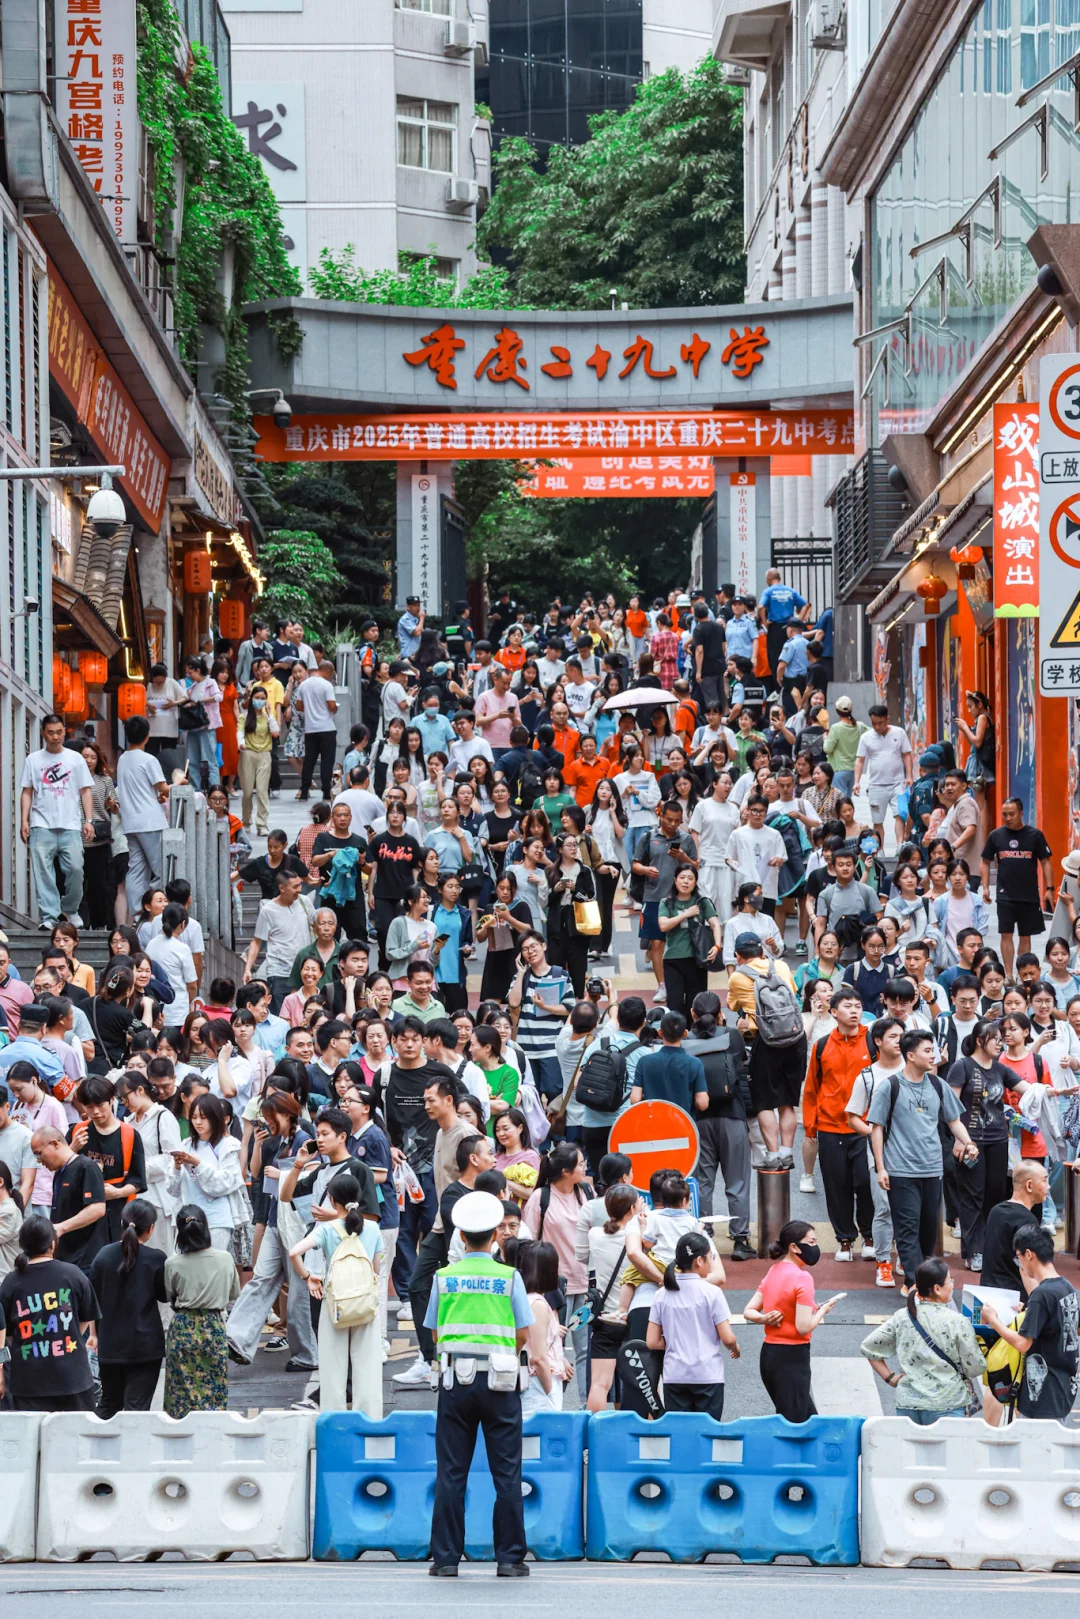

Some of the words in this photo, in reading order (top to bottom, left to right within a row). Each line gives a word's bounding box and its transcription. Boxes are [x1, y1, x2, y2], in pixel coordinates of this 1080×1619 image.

[402, 323, 771, 391] 重庆二十九中学
[445, 1276, 459, 1293] 警
[461, 1279, 490, 1290] POLICE
[492, 1278, 506, 1295] 察
[16, 1288, 72, 1318] LUCK
